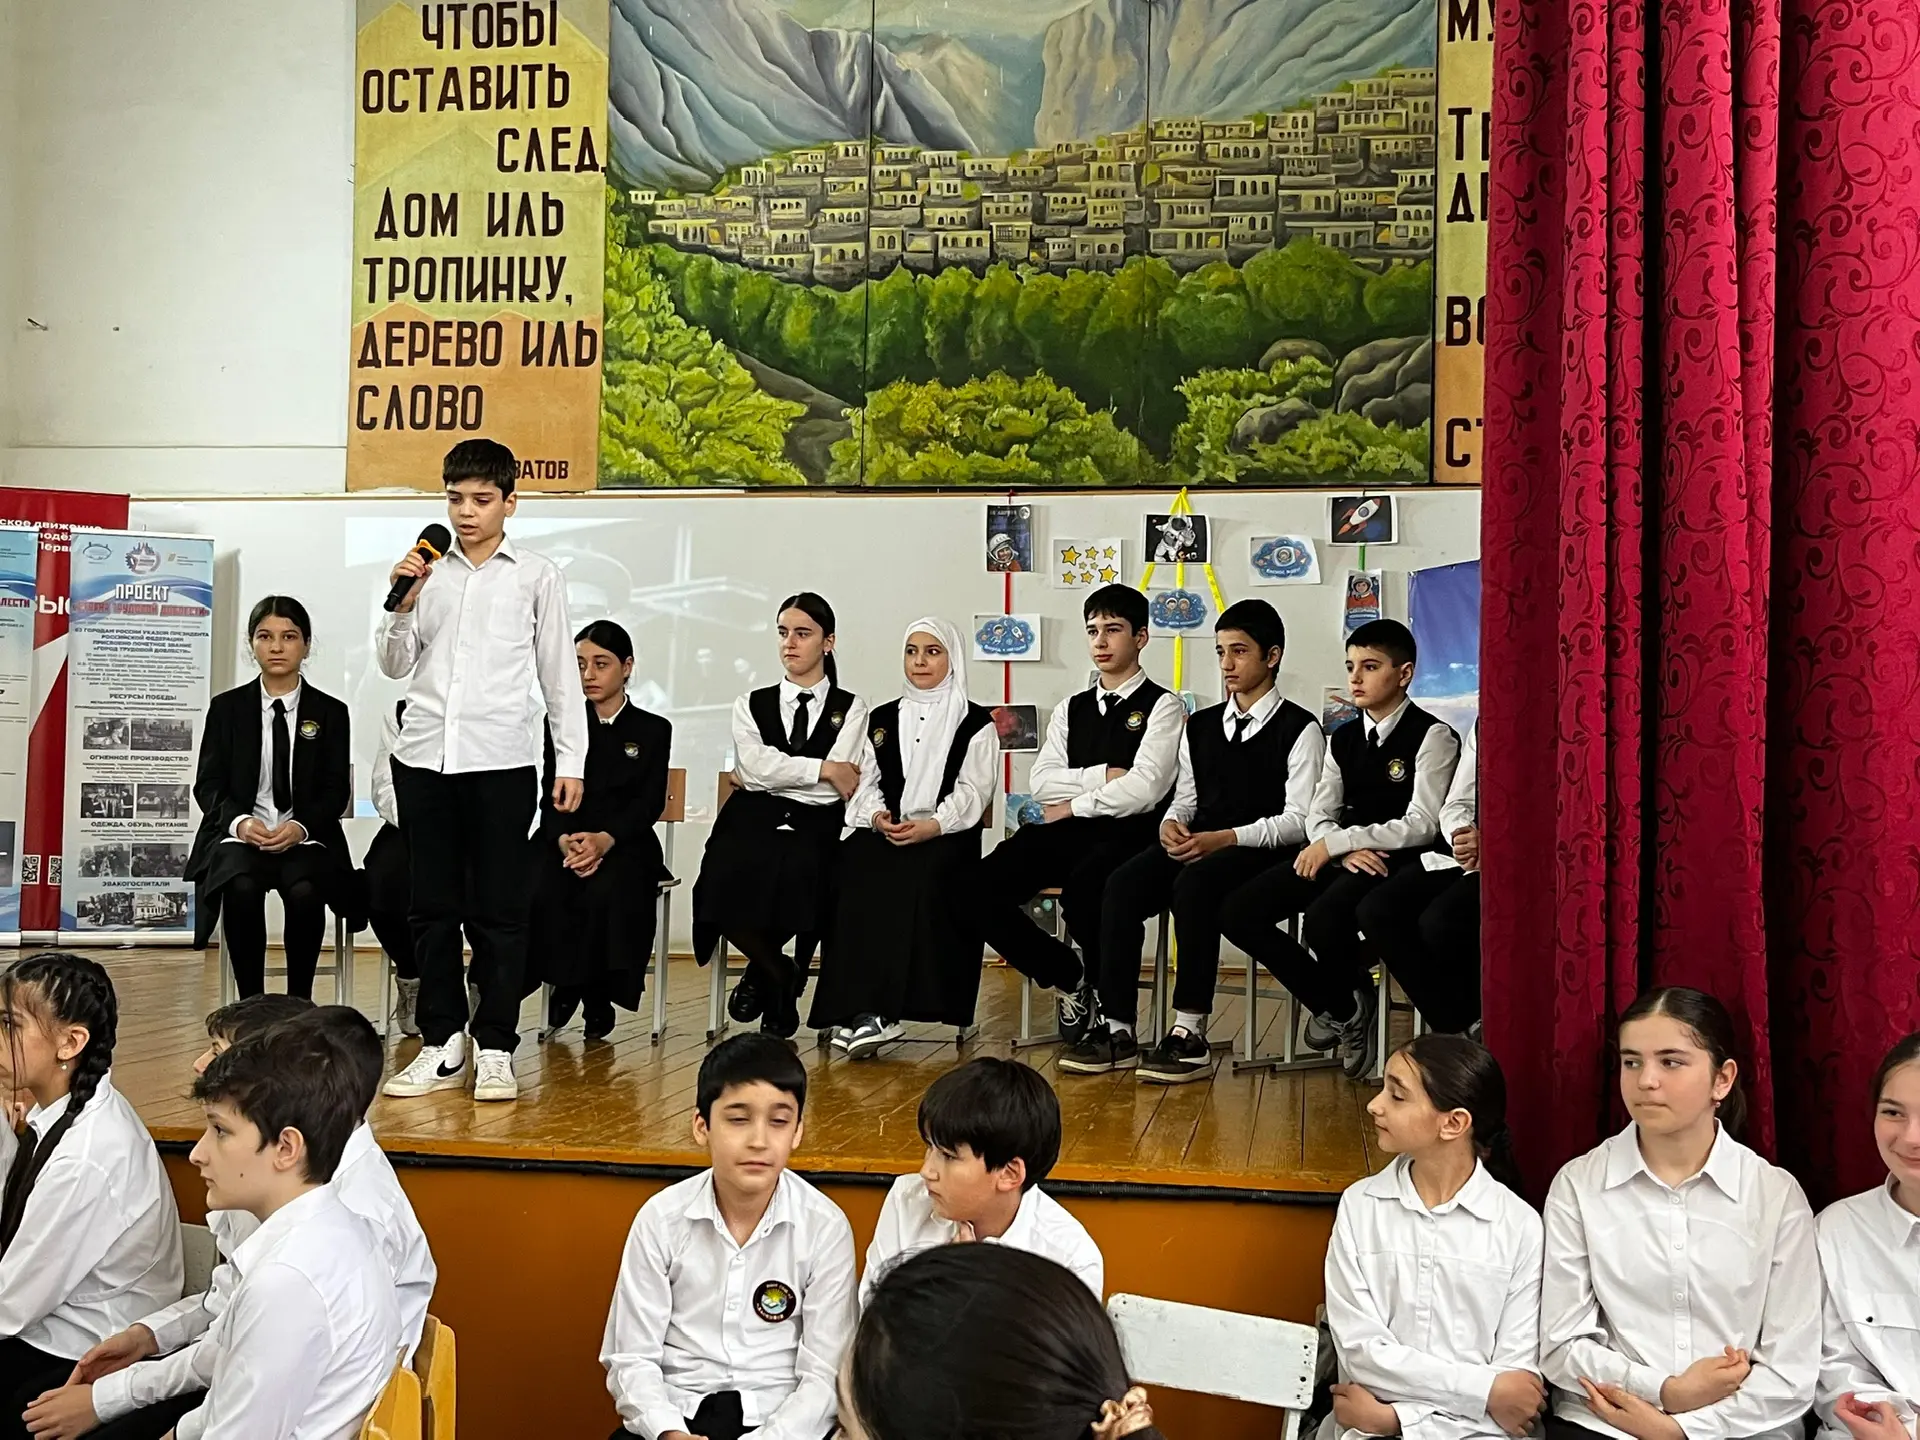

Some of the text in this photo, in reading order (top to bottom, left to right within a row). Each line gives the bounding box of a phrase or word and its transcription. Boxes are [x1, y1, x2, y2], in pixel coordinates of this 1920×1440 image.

[422, 0, 557, 50] ЧТОБЫ
[362, 63, 570, 114] ОСТАВИТЬ
[374, 187, 564, 241] ДОМ ИЛЬ
[363, 256, 573, 307] ТРОПИНКУ,
[357, 320, 598, 369] ДЕРЕВО ИЛЬ
[356, 384, 483, 431] СЛОВО
[115, 583, 169, 601] ПРОЕКТ
